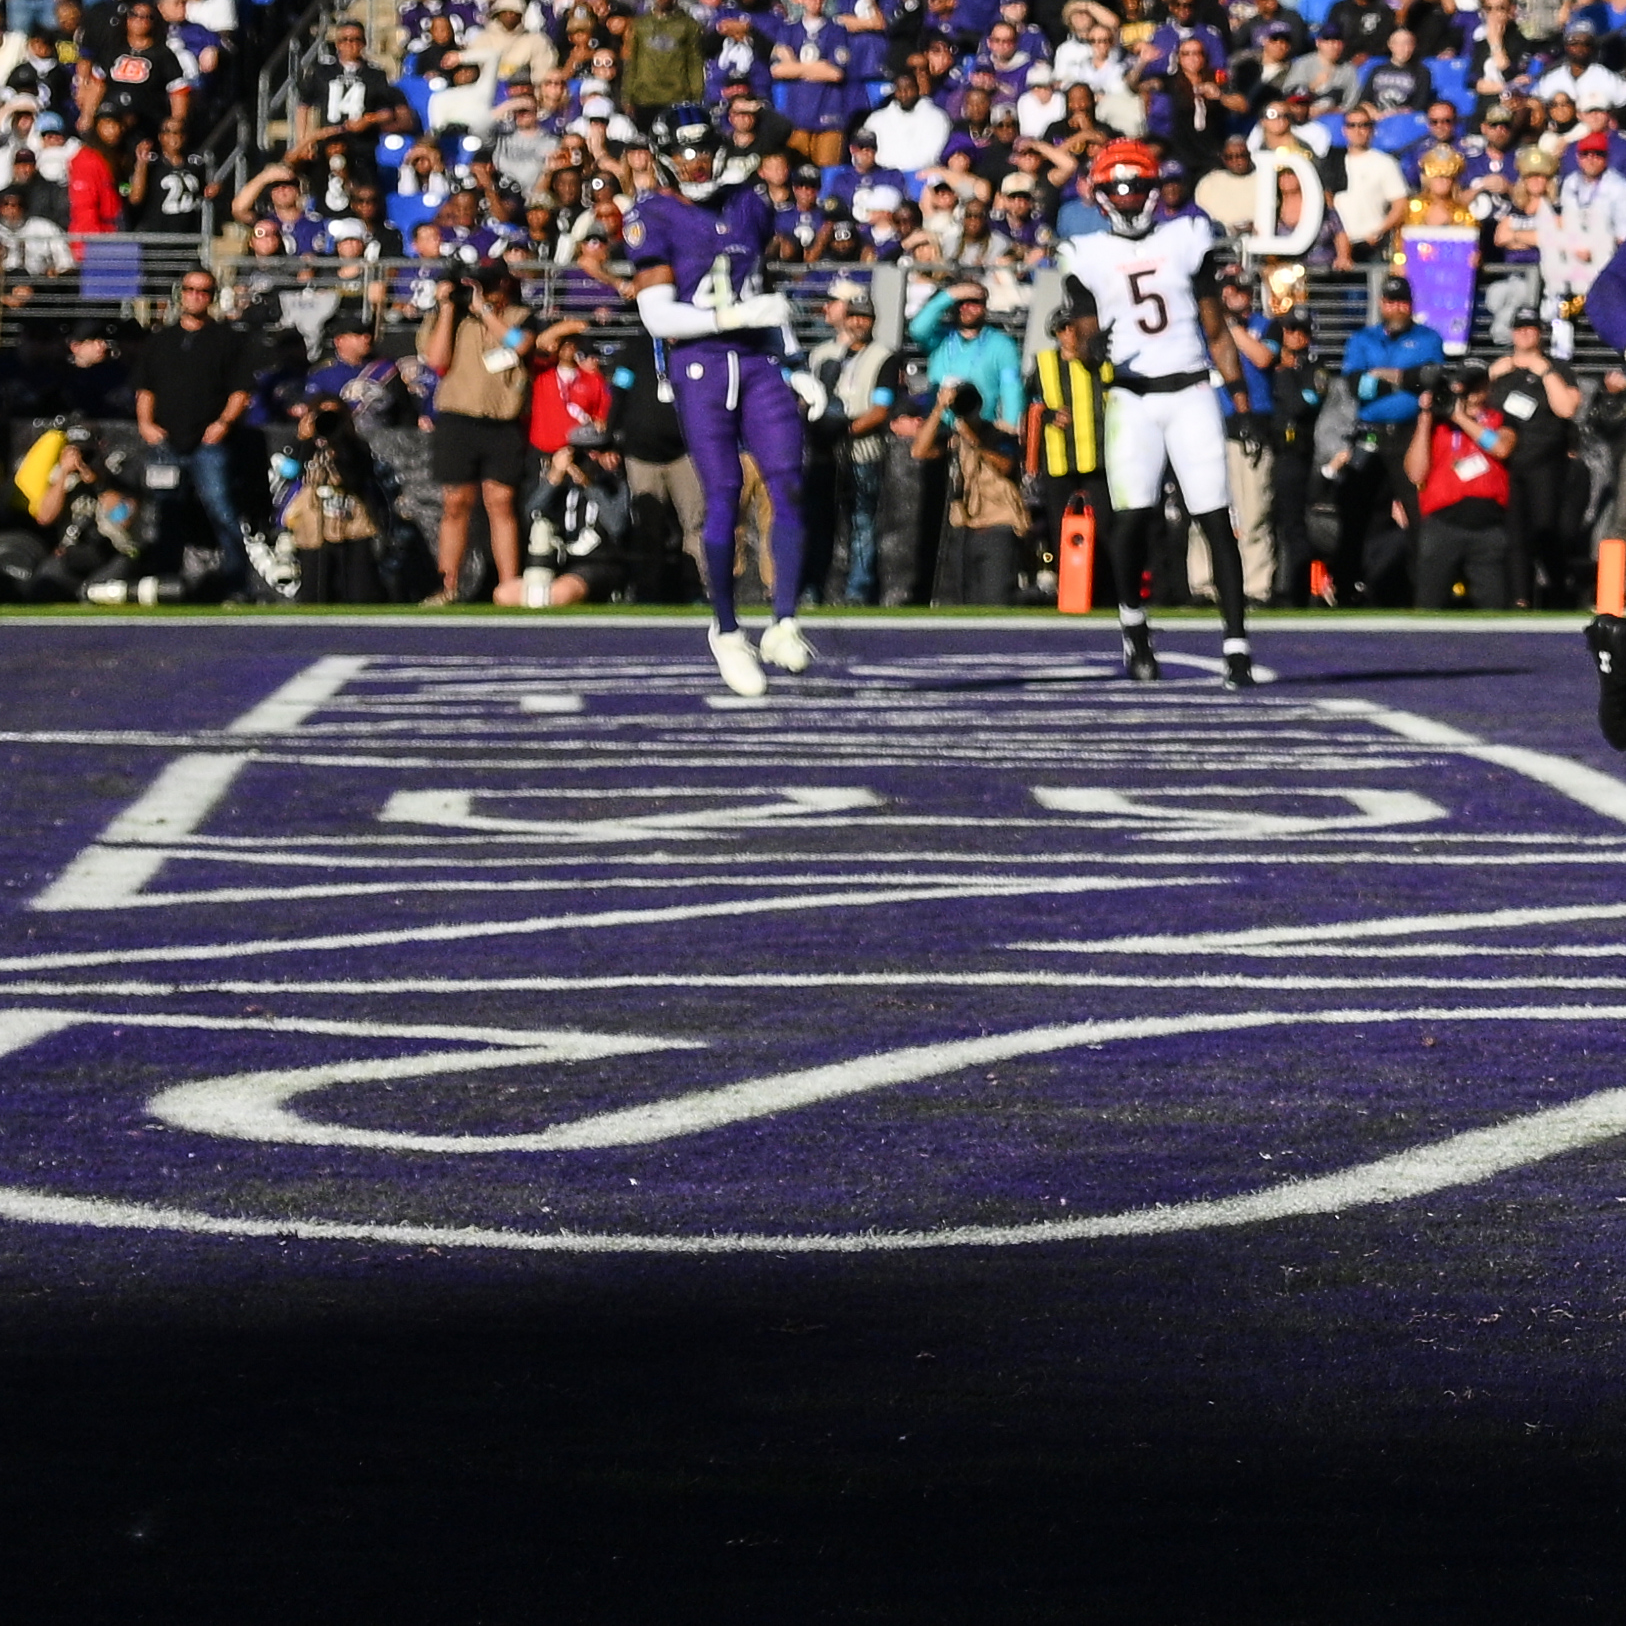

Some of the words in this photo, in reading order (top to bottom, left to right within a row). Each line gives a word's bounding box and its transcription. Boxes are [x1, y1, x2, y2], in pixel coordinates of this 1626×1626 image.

[327, 75, 364, 123] 14
[1243, 150, 1325, 256] D
[1126, 269, 1168, 335] 5
